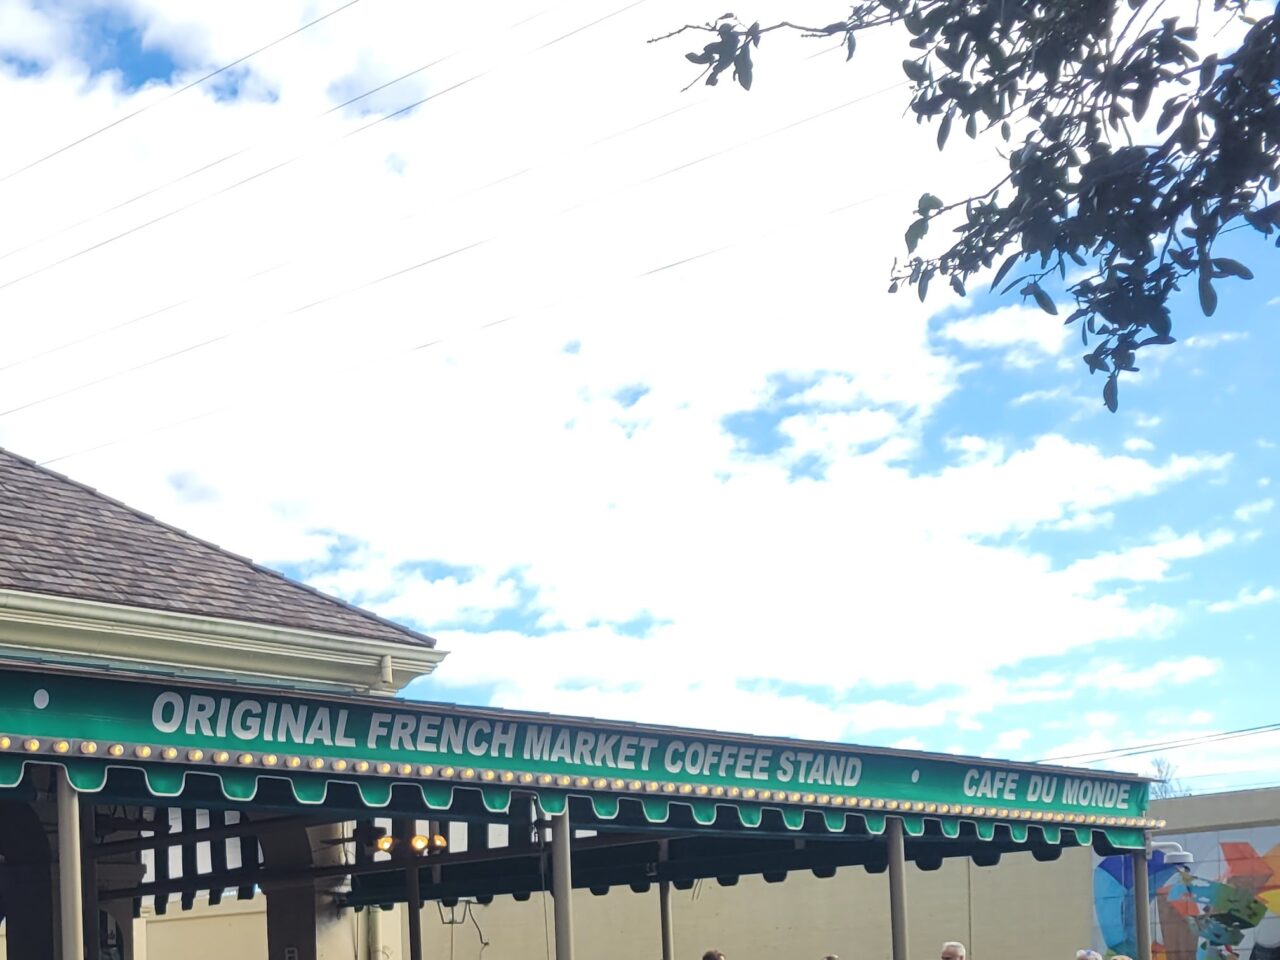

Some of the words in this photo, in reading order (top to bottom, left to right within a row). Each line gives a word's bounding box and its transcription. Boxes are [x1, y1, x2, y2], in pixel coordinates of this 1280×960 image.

[151, 691, 357, 748] ORIGINAL
[367, 712, 518, 759] FRENCH
[523, 724, 660, 771] MARKET
[664, 740, 773, 780] COFFEE
[776, 750, 864, 787] STAND
[963, 768, 1020, 801] CAFE
[1026, 775, 1058, 804] DU
[1062, 778, 1132, 810] MONDE
